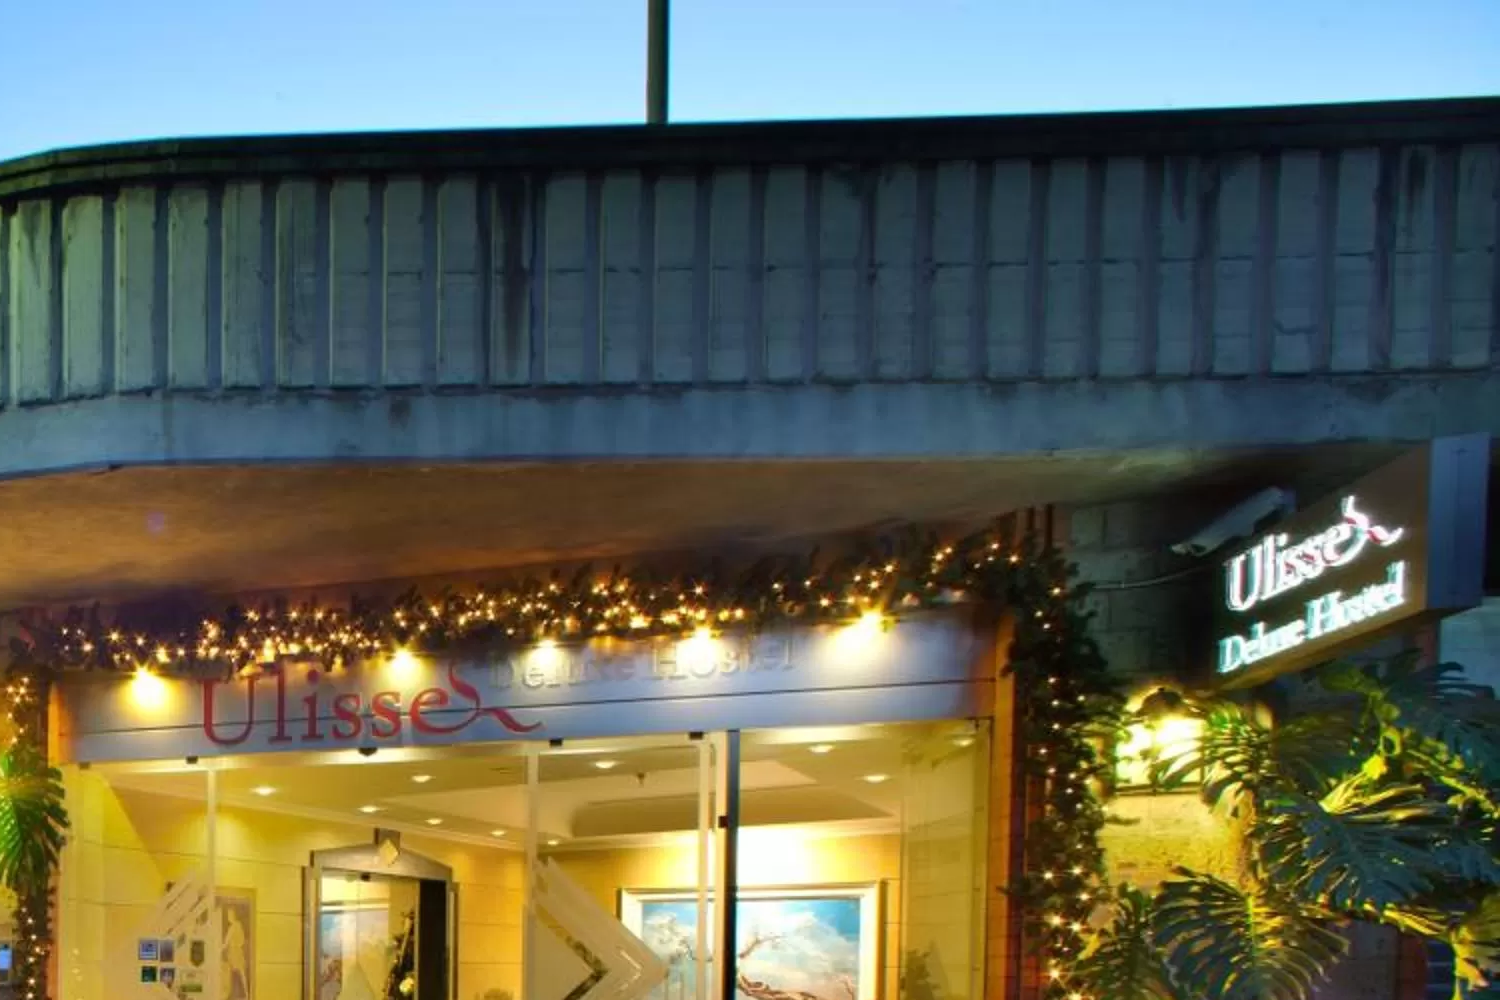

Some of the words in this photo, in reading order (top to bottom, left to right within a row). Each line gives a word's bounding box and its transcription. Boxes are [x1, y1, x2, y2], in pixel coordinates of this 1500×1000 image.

[1224, 495, 1403, 611] Ulisse
[1217, 620, 1306, 673] Deluxe
[1305, 561, 1405, 640] Hostel
[202, 661, 542, 746] Ulisse
